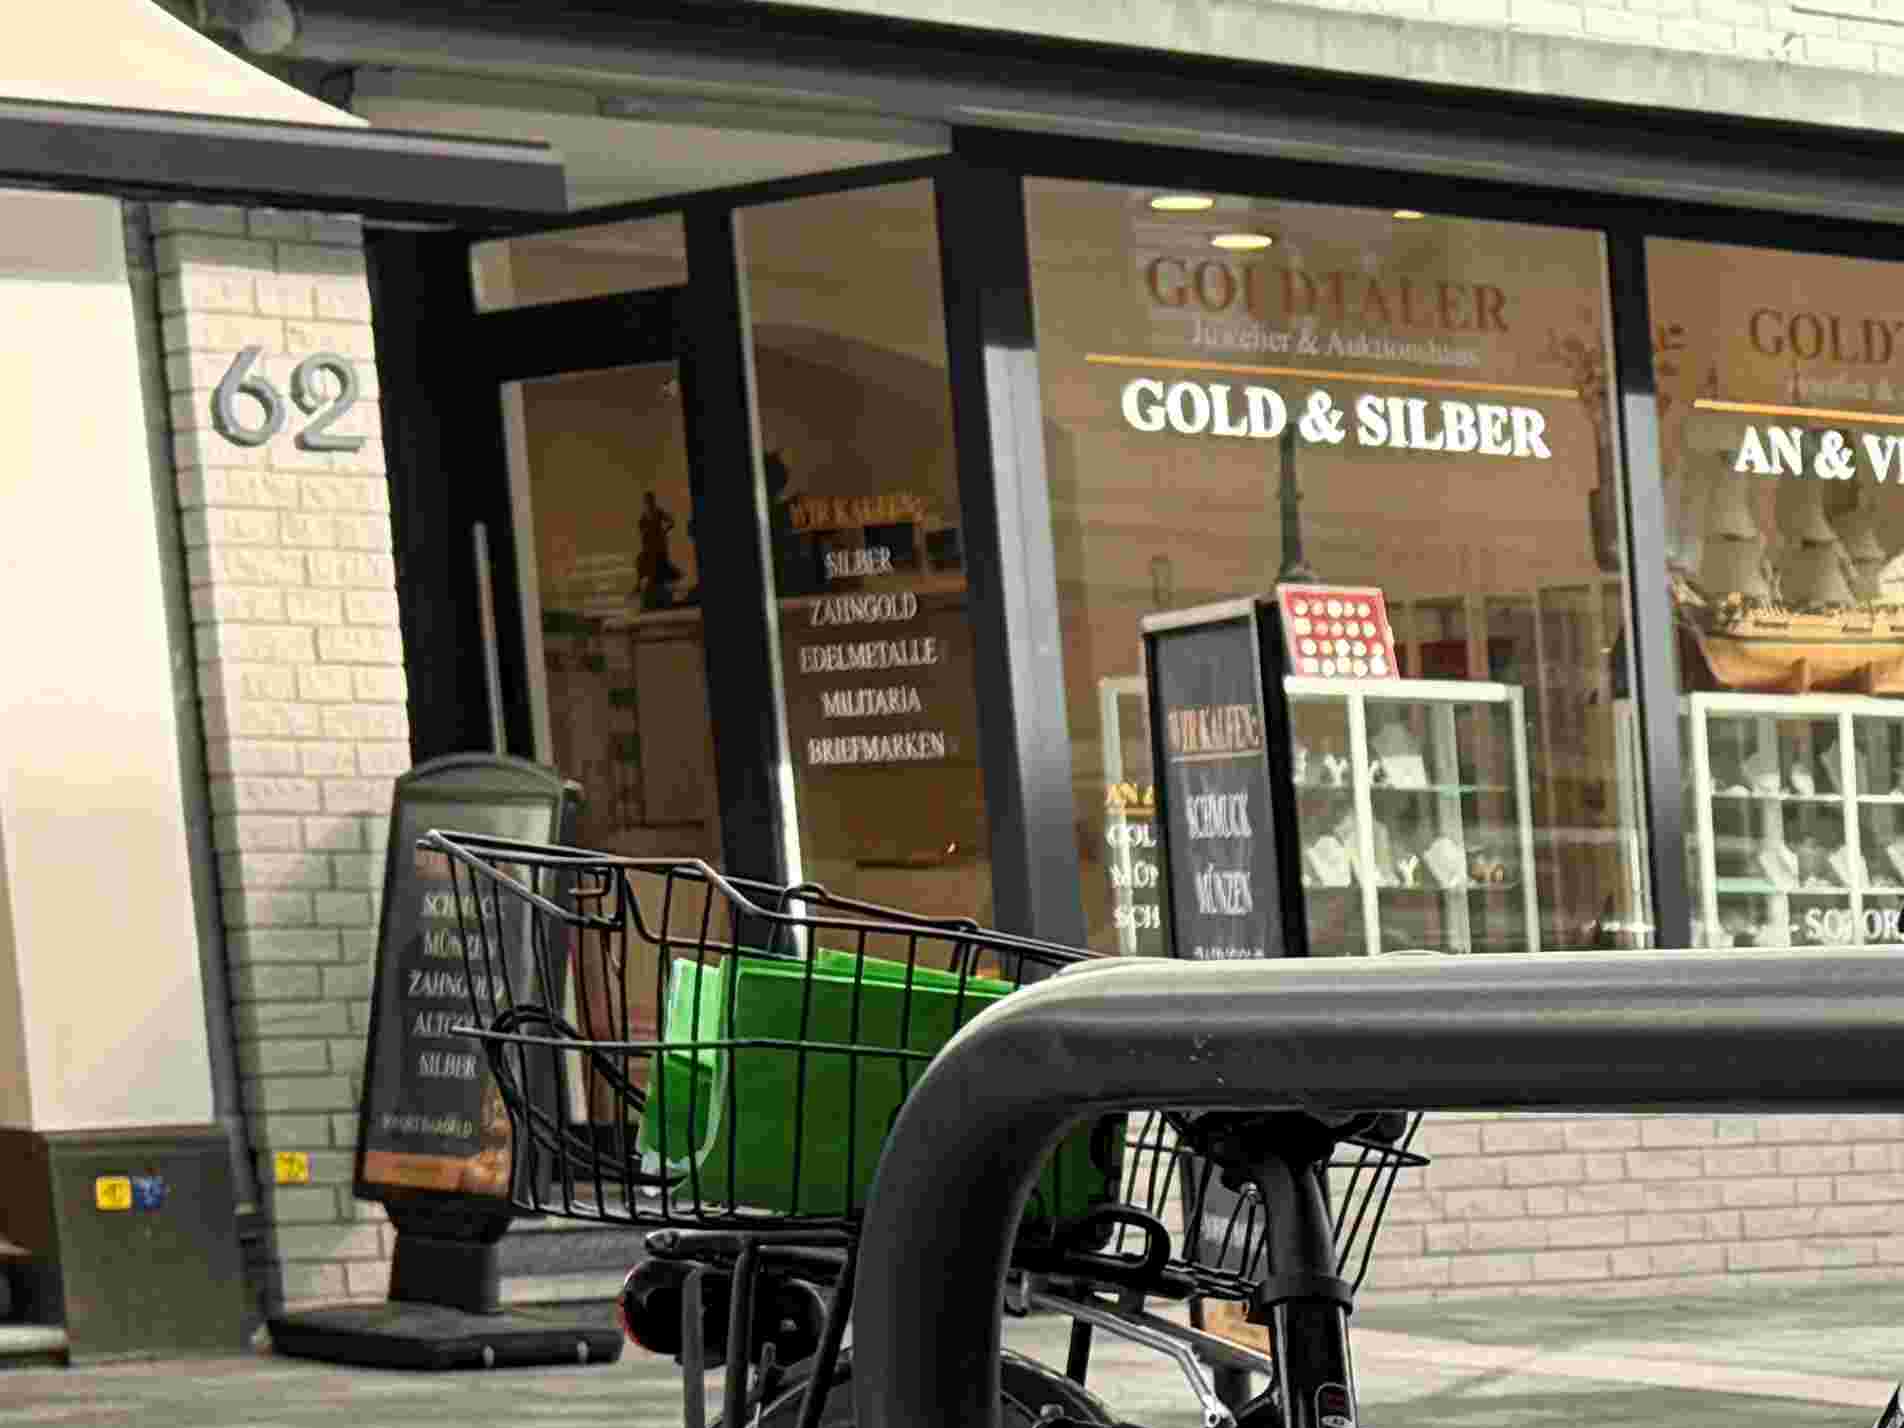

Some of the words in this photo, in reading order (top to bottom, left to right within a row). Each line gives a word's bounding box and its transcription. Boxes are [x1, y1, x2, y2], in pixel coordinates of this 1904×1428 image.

[1146, 256, 1509, 333] GOLDTALER
[209, 345, 368, 454] 62
[1121, 378, 1288, 440] GOLD
[1299, 390, 1347, 445] &
[1356, 394, 1553, 459] SILBER
[1734, 425, 1803, 476] AN
[1813, 430, 1856, 481] &
[824, 547, 893, 579] SILBER
[808, 591, 919, 627] ZAHNGOLD
[800, 637, 939, 673] EDELMETALLE
[820, 685, 921, 718] MILITARIA
[807, 731, 945, 765] BRIEFMARKEN
[1186, 791, 1252, 840] SCHMUCK
[1195, 863, 1253, 916] MÜNZEN
